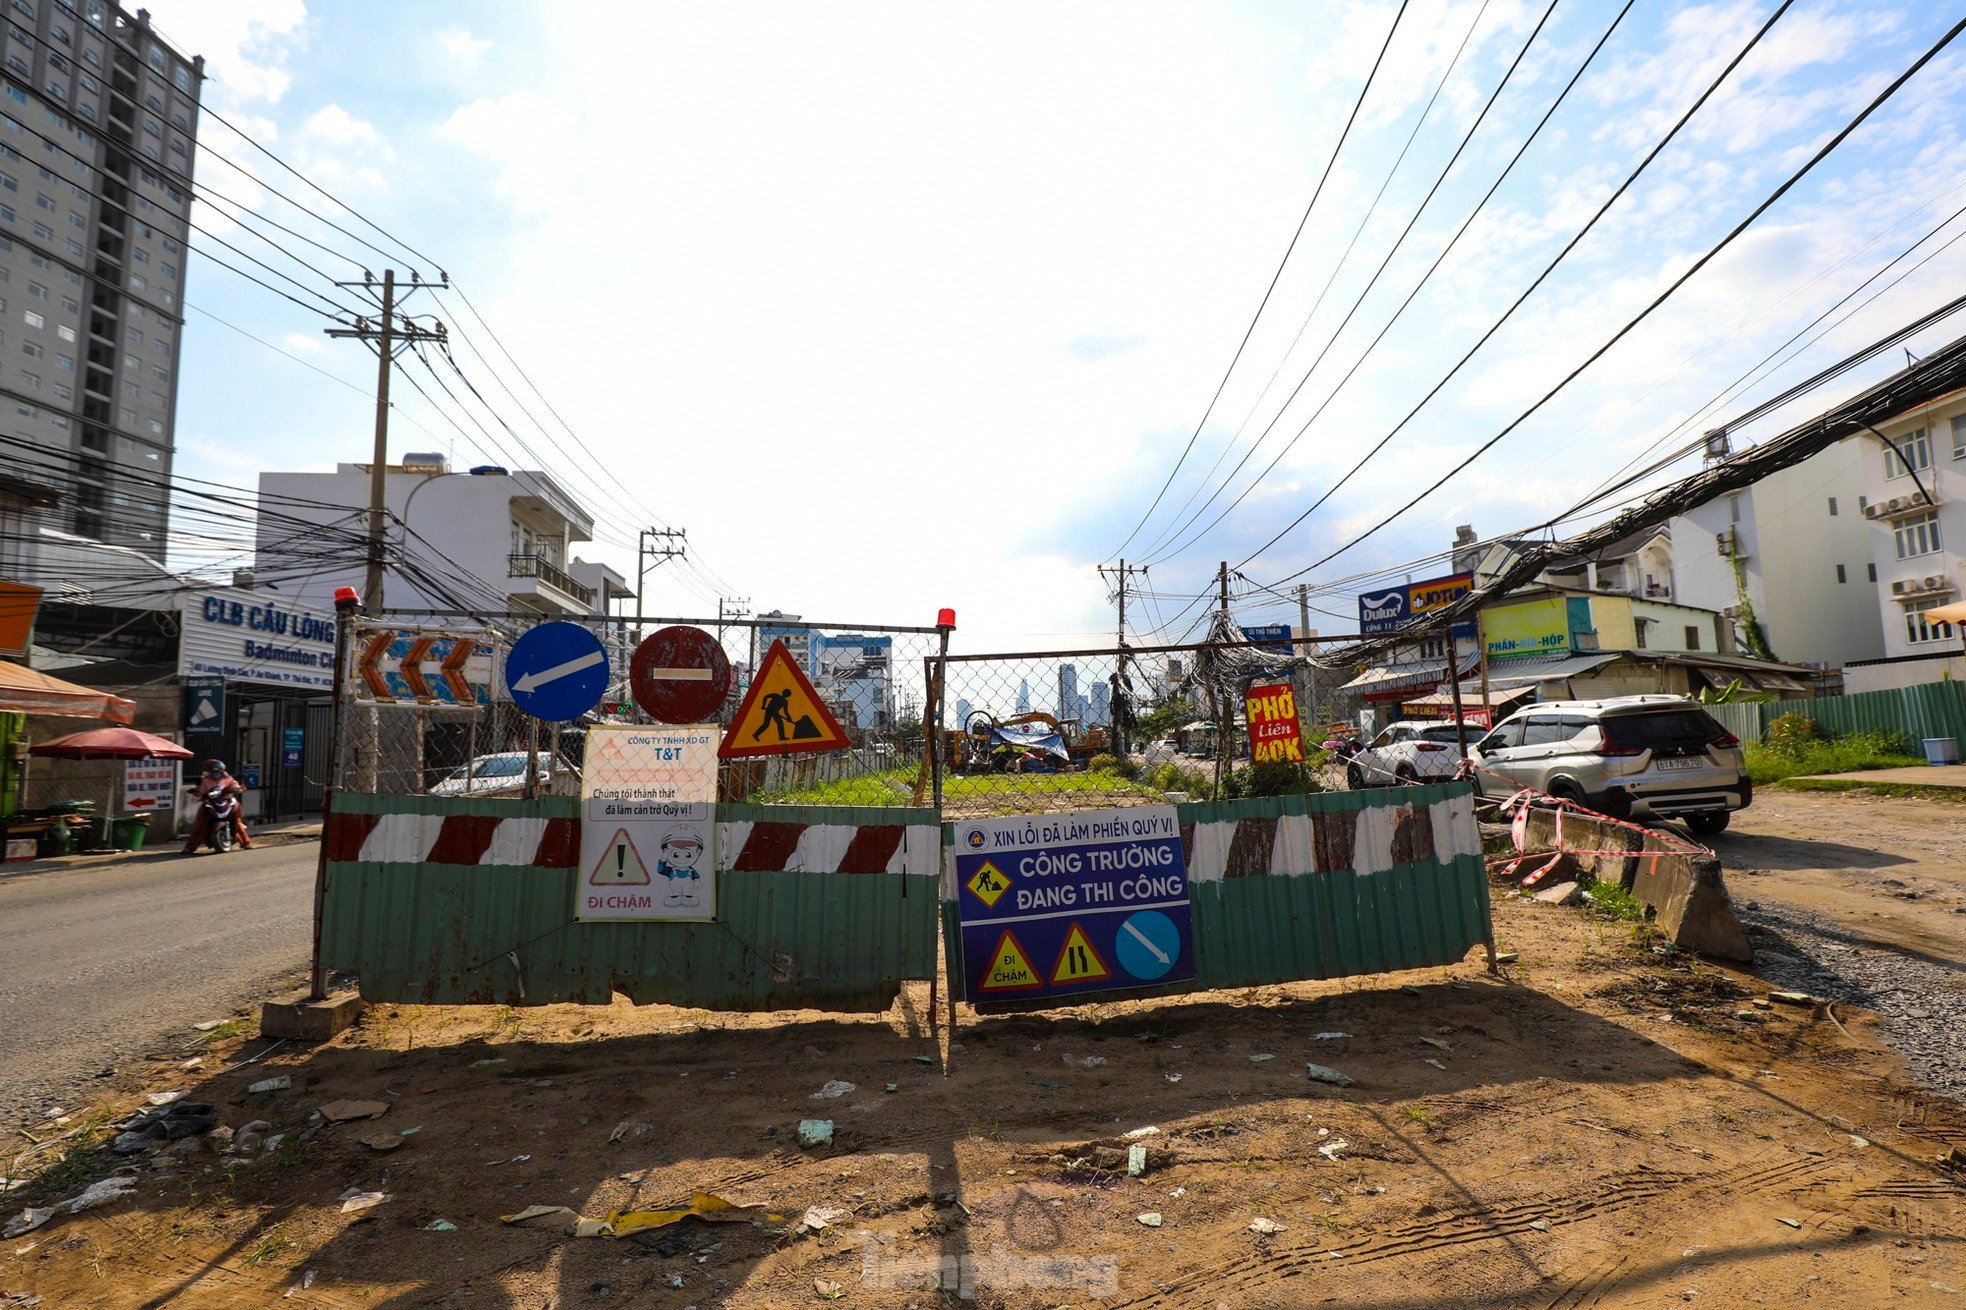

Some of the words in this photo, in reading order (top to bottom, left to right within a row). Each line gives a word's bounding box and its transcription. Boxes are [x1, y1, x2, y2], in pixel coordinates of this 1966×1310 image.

[204, 596, 244, 626] CLB
[292, 612, 335, 643] LÔNG
[1363, 607, 1397, 621] Dulux
[245, 640, 317, 667] Badminton
[320, 652, 335, 669] Cl
[1246, 686, 1295, 723] PHỞ
[1259, 723, 1292, 738] Liên
[628, 736, 650, 745] CÔNG
[651, 737, 661, 745] TY
[663, 737, 685, 745] TNHH
[686, 737, 697, 745] XD
[699, 737, 710, 745] GT
[655, 747, 682, 761] T&T
[1255, 737, 1303, 762] 40K
[593, 788, 619, 800] Chúng
[621, 789, 632, 799] tôi
[633, 788, 656, 799] thành
[659, 788, 675, 801] thật
[605, 804, 616, 815] đã
[617, 804, 634, 815] làm
[634, 804, 648, 815] cản
[650, 804, 661, 815] trở
[663, 804, 679, 817] Quý
[993, 830, 1015, 847] XIN
[1018, 821, 1039, 845] LỖI
[1043, 823, 1061, 843] ĐÃ
[1064, 821, 1090, 841] LÀM
[1093, 816, 1130, 838] PHIỀN
[1132, 815, 1158, 836] QUÝ
[1161, 817, 1174, 836] VỊ
[1019, 851, 1082, 878] CÔNG
[1086, 843, 1173, 872] TRƯỜNG
[1016, 885, 1077, 910] ĐANG
[1081, 881, 1114, 903] THI
[1119, 873, 1183, 900] CÔNG
[587, 896, 603, 908] ĐI
[607, 894, 651, 911] CHẬM
[1004, 955, 1015, 965] ĐI
[994, 969, 1027, 984] CHẬM
